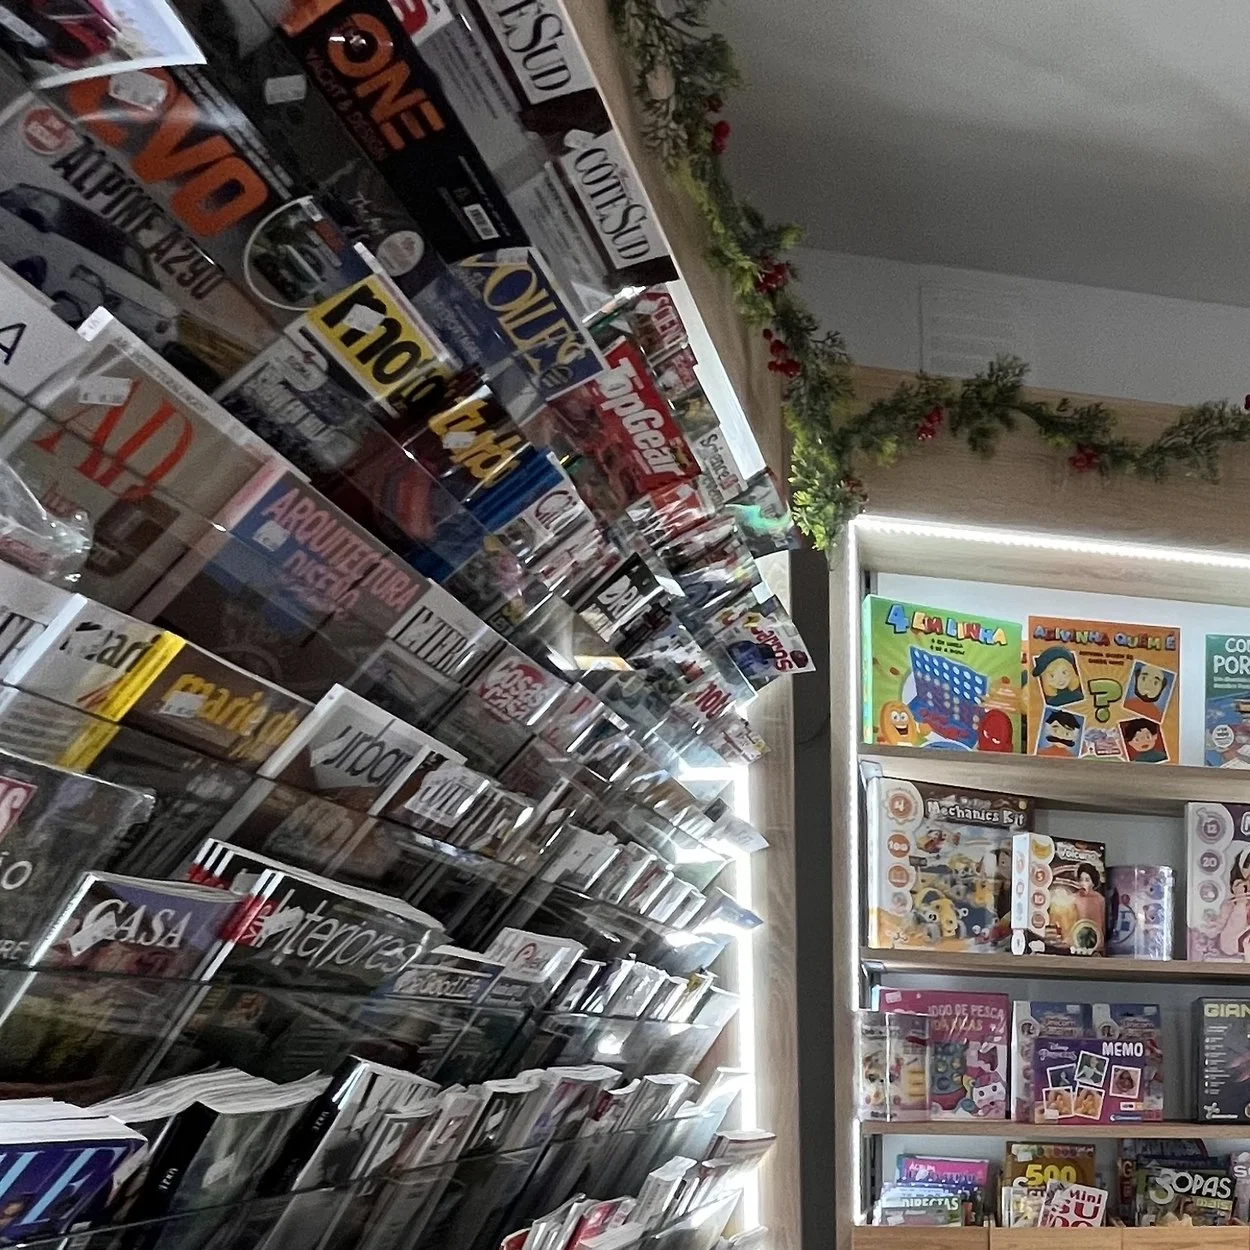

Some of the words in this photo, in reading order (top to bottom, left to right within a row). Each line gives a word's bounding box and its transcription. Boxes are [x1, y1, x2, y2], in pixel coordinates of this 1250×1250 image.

[600, 356, 686, 476] TopGear
[886, 604, 909, 633] 4
[911, 611, 943, 634] EM
[947, 617, 1007, 646] LINHA
[1033, 625, 1109, 646] ADIVINHA
[1113, 632, 1162, 650] QUEM
[1165, 628, 1176, 650] É
[927, 800, 999, 822] Mechanics
[1002, 810, 1025, 826] Kit
[1202, 857, 1218, 867] 20
[81, 897, 192, 949] CASA
[954, 1004, 968, 1016] DE
[970, 1004, 1004, 1021] PESCA
[1102, 1041, 1143, 1057] MEMO
[1025, 1164, 1078, 1186] 500
[1150, 1168, 1232, 1206] SOPAS
